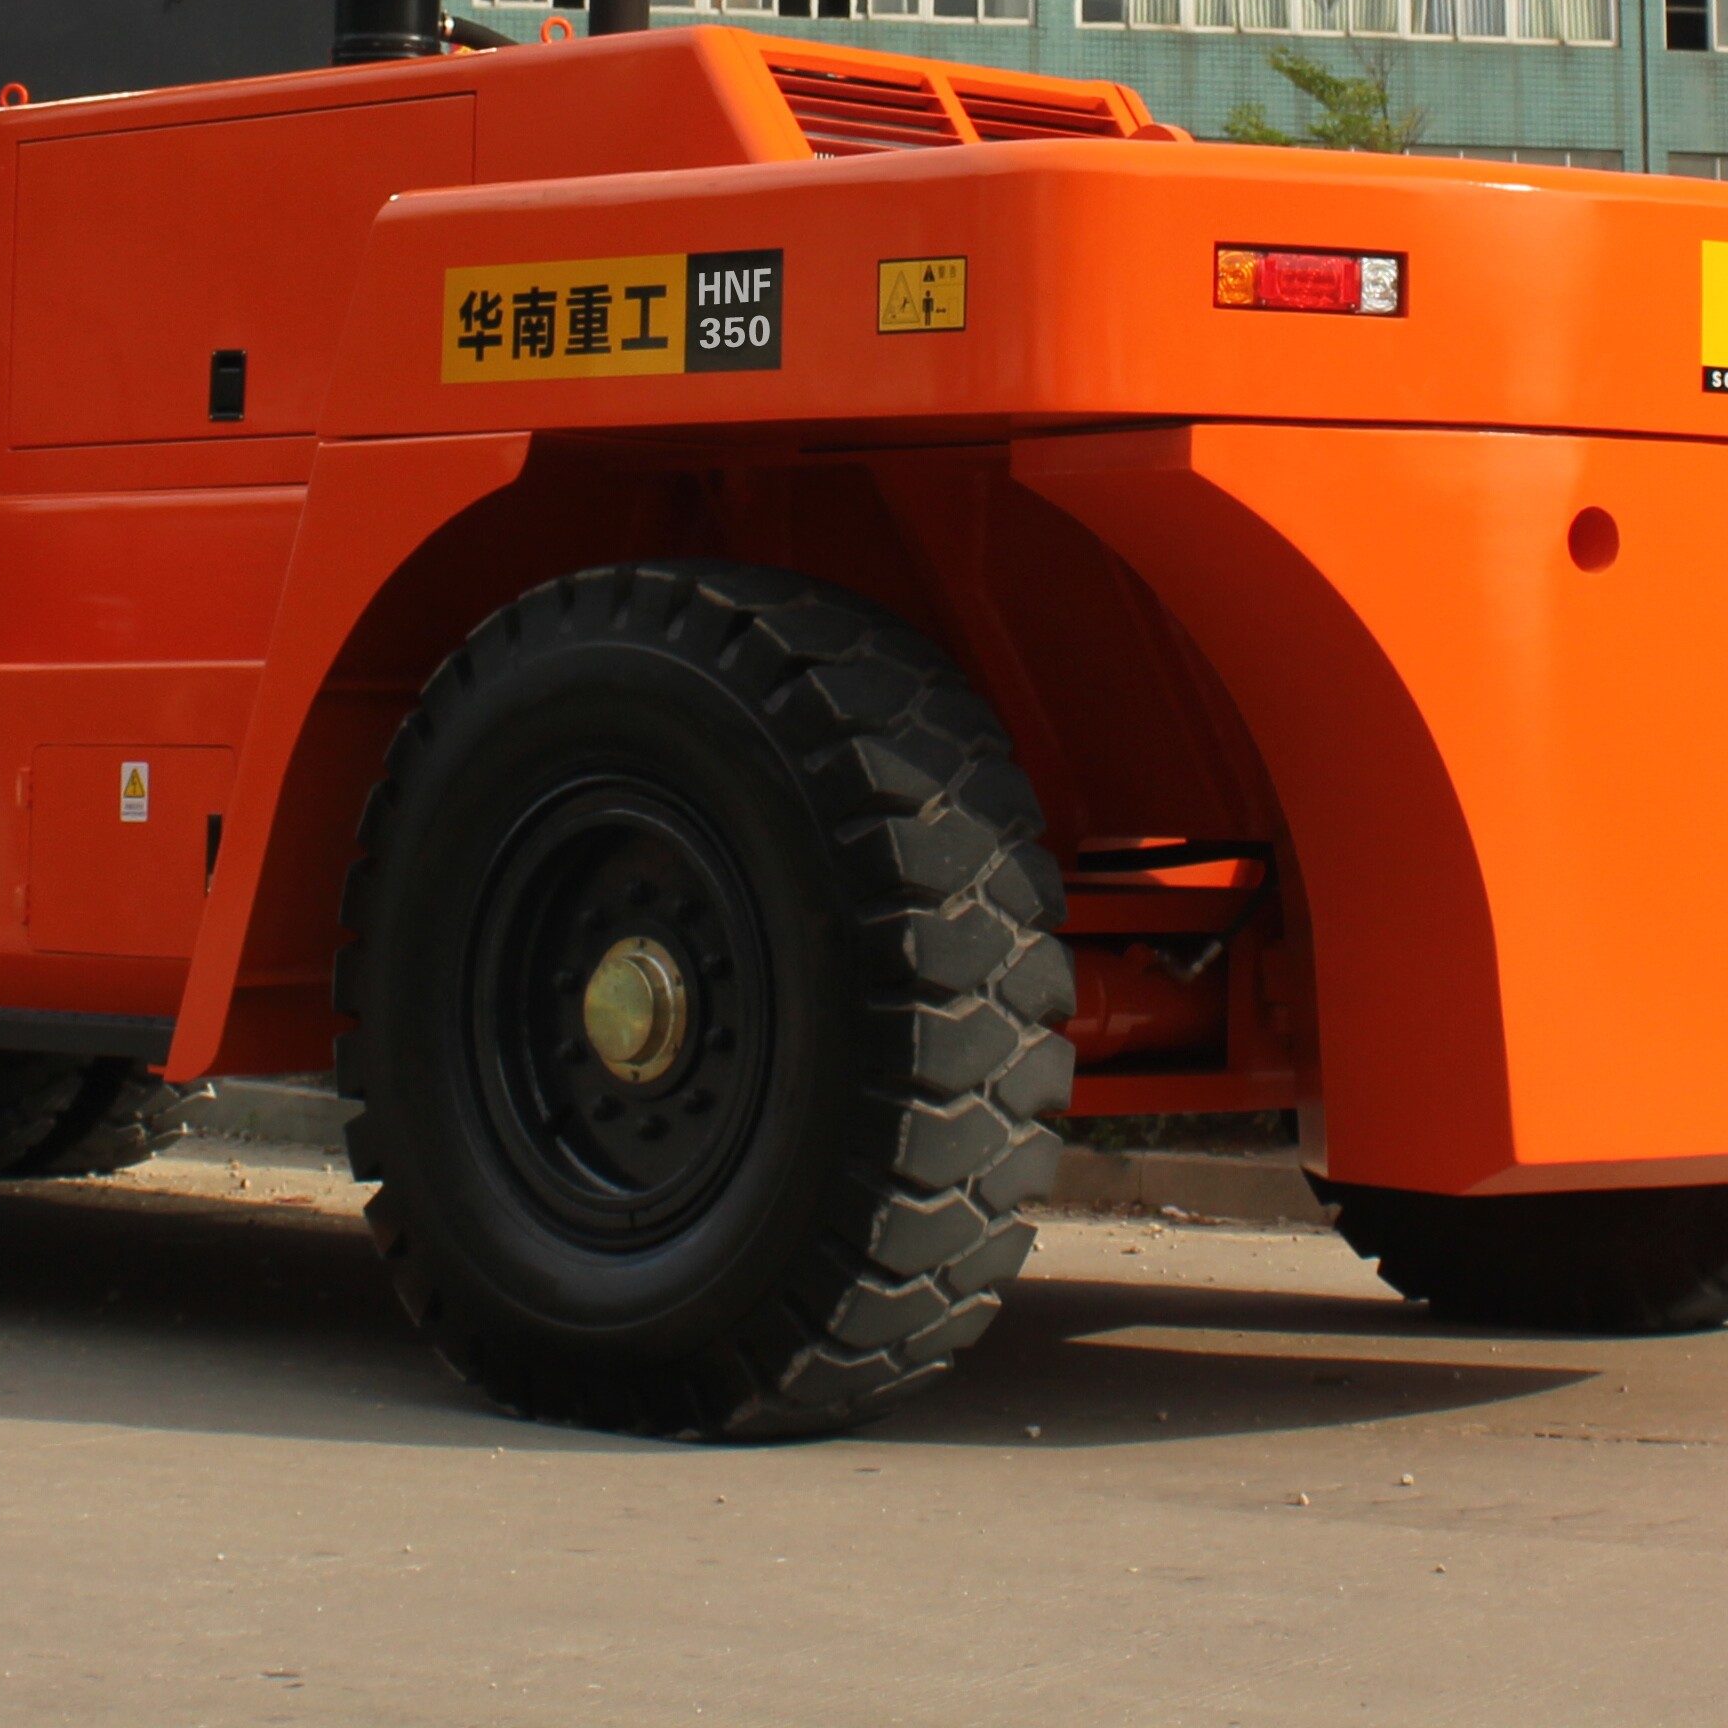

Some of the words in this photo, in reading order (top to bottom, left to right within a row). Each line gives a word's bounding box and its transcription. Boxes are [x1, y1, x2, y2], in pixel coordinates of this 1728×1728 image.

[698, 268, 772, 307] HNF
[457, 284, 669, 362] 华南重工
[698, 315, 771, 350] 350
